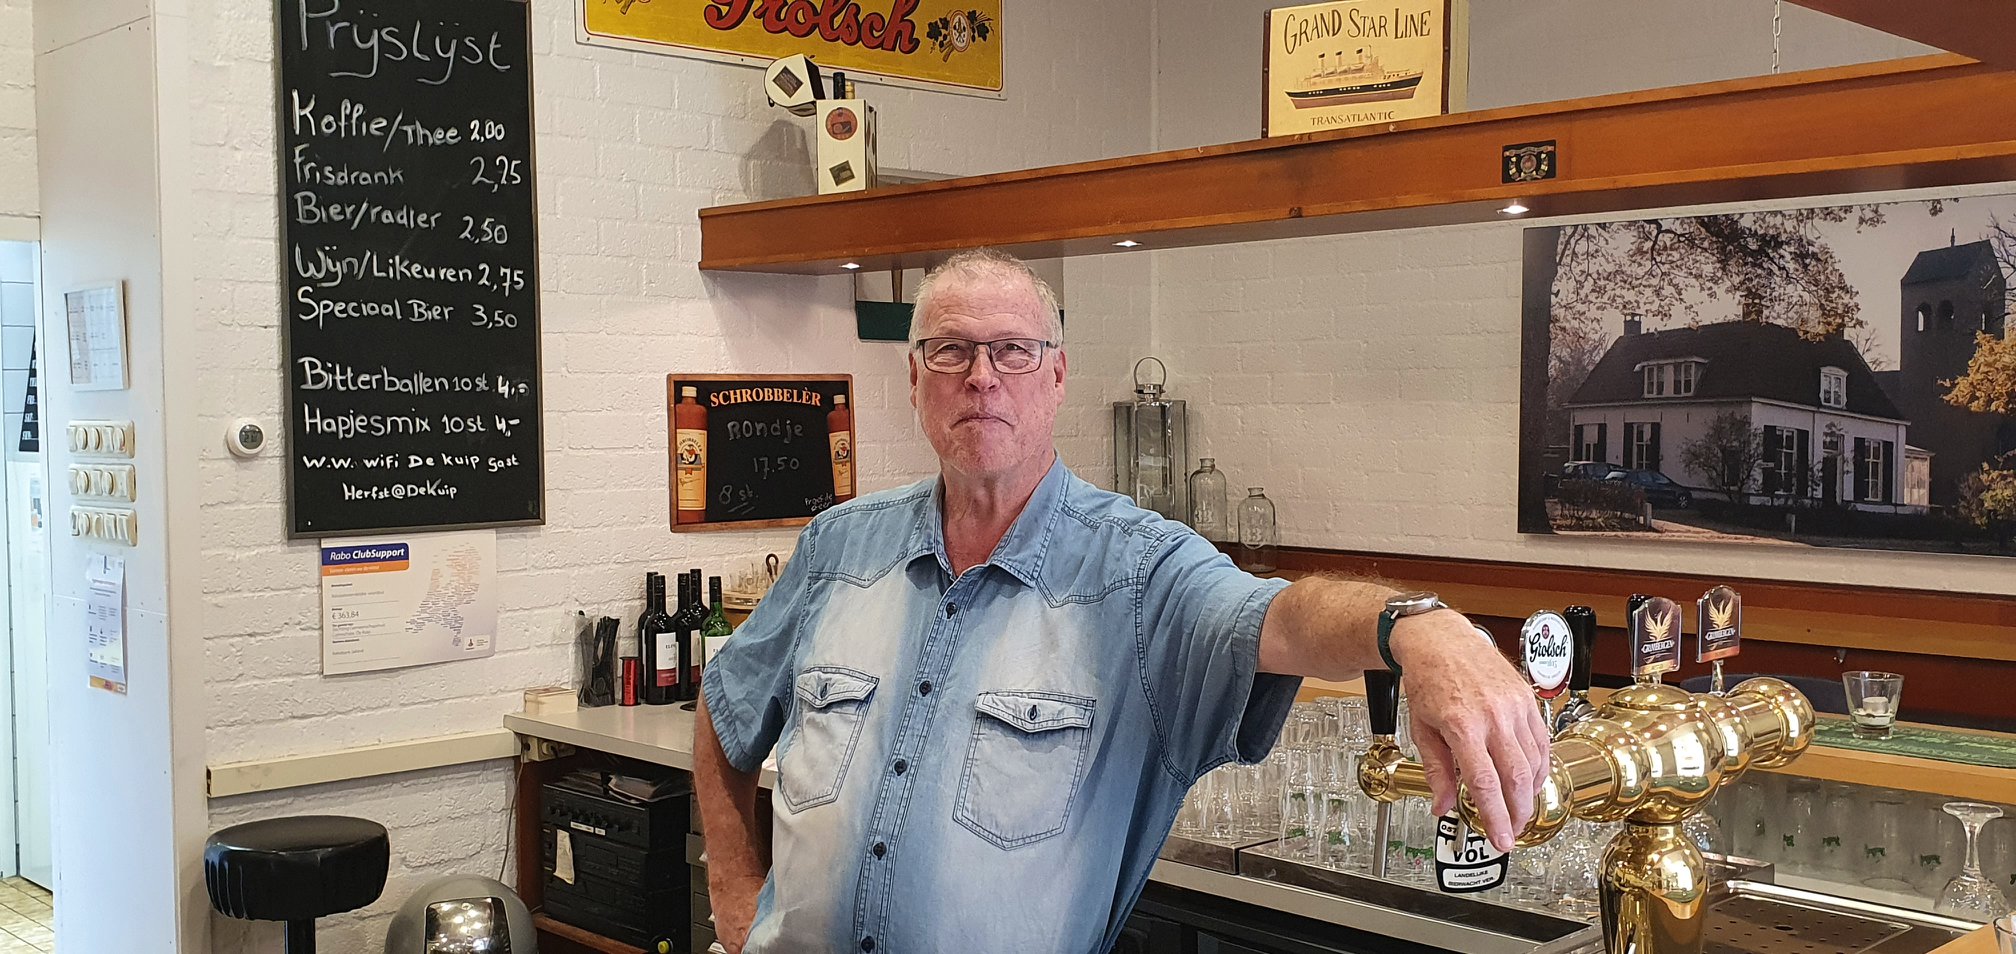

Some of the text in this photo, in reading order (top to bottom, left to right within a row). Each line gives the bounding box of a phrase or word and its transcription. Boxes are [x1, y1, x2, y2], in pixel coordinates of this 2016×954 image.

[1284, 8, 1431, 55] GRAND STAR LINE
[470, 119, 505, 143] 2,00
[1310, 111, 1395, 126] TRANSATLANTIC
[294, 143, 522, 193] Frisdrank 2,25
[294, 191, 508, 245] Bier/radler 2,50
[478, 263, 524, 297] 2,75
[297, 286, 518, 331] Speciaal Bier 3,50
[297, 357, 449, 395] Bitterballen
[452, 376, 471, 391] 10
[710, 387, 821, 407] SCHROBBELÈR
[304, 403, 431, 439] Hapjesmix
[407, 454, 435, 469] De
[753, 456, 799, 479] 17.50
[342, 478, 457, 500] Herfst@DeKuip
[719, 484, 732, 504] 8
[330, 548, 405, 561] Rabo ClubSupport
[1529, 633, 1568, 662] Grolsch
